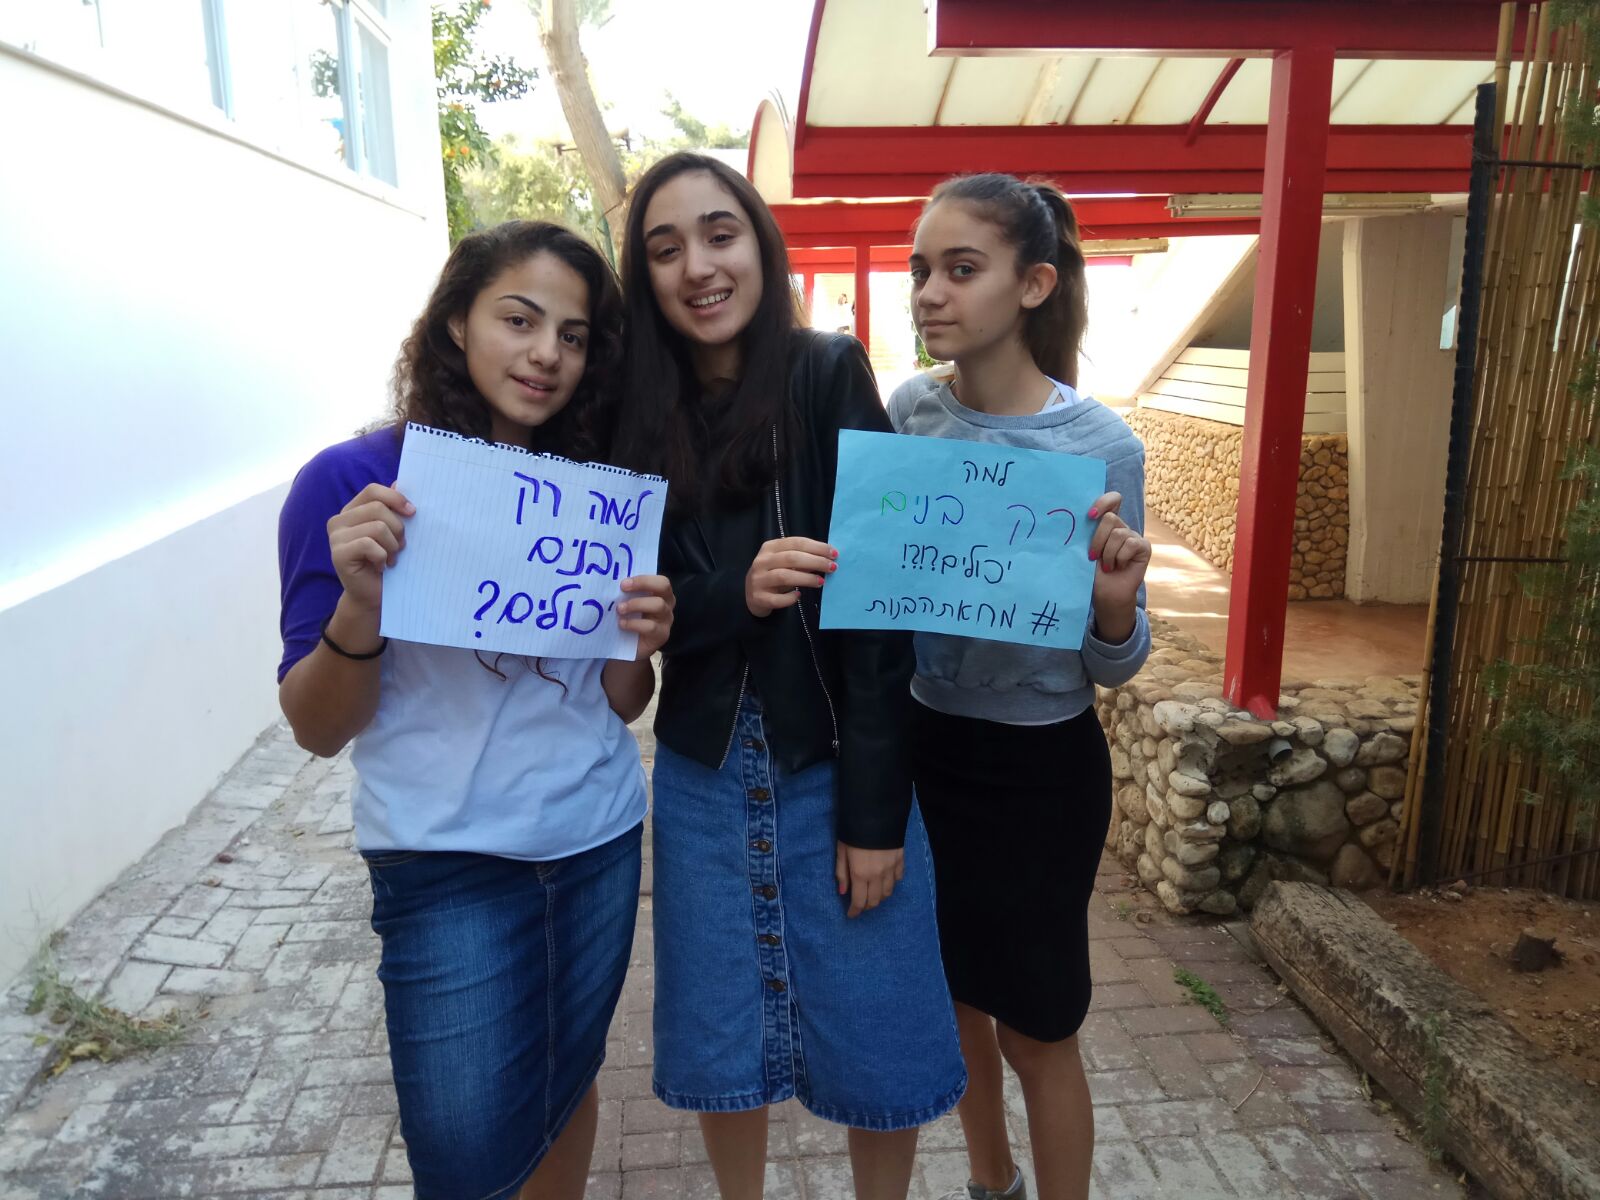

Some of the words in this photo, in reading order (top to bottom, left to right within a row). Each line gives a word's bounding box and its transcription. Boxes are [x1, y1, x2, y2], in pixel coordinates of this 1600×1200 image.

[963, 460, 1015, 487] למה
[513, 470, 562, 526] רק
[588, 489, 654, 531] למה
[881, 490, 965, 526] בנים
[1006, 503, 1076, 546] רק
[527, 535, 633, 580] הבנים
